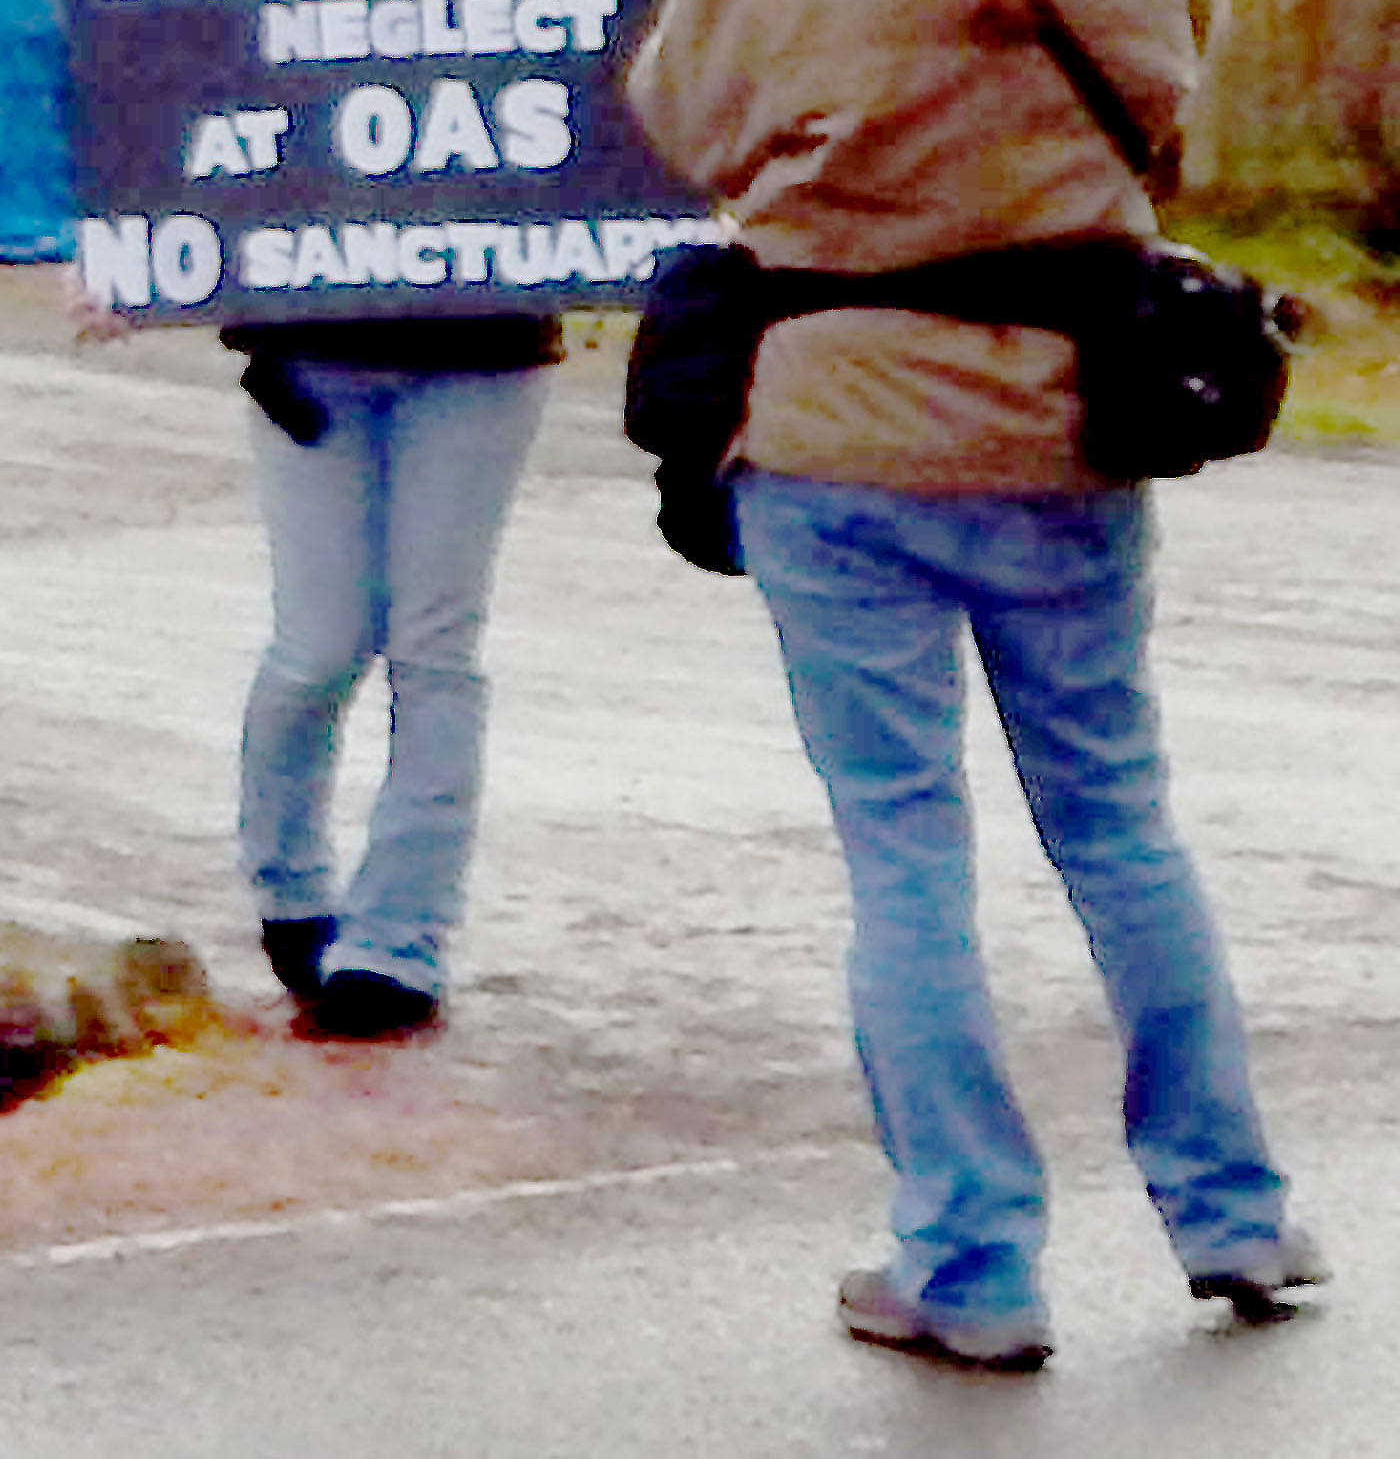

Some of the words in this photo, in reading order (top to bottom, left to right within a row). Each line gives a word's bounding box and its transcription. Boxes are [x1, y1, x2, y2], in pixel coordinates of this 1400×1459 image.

[186, 108, 290, 179] AT
[338, 77, 574, 175] OAS
[80, 214, 222, 309] NO
